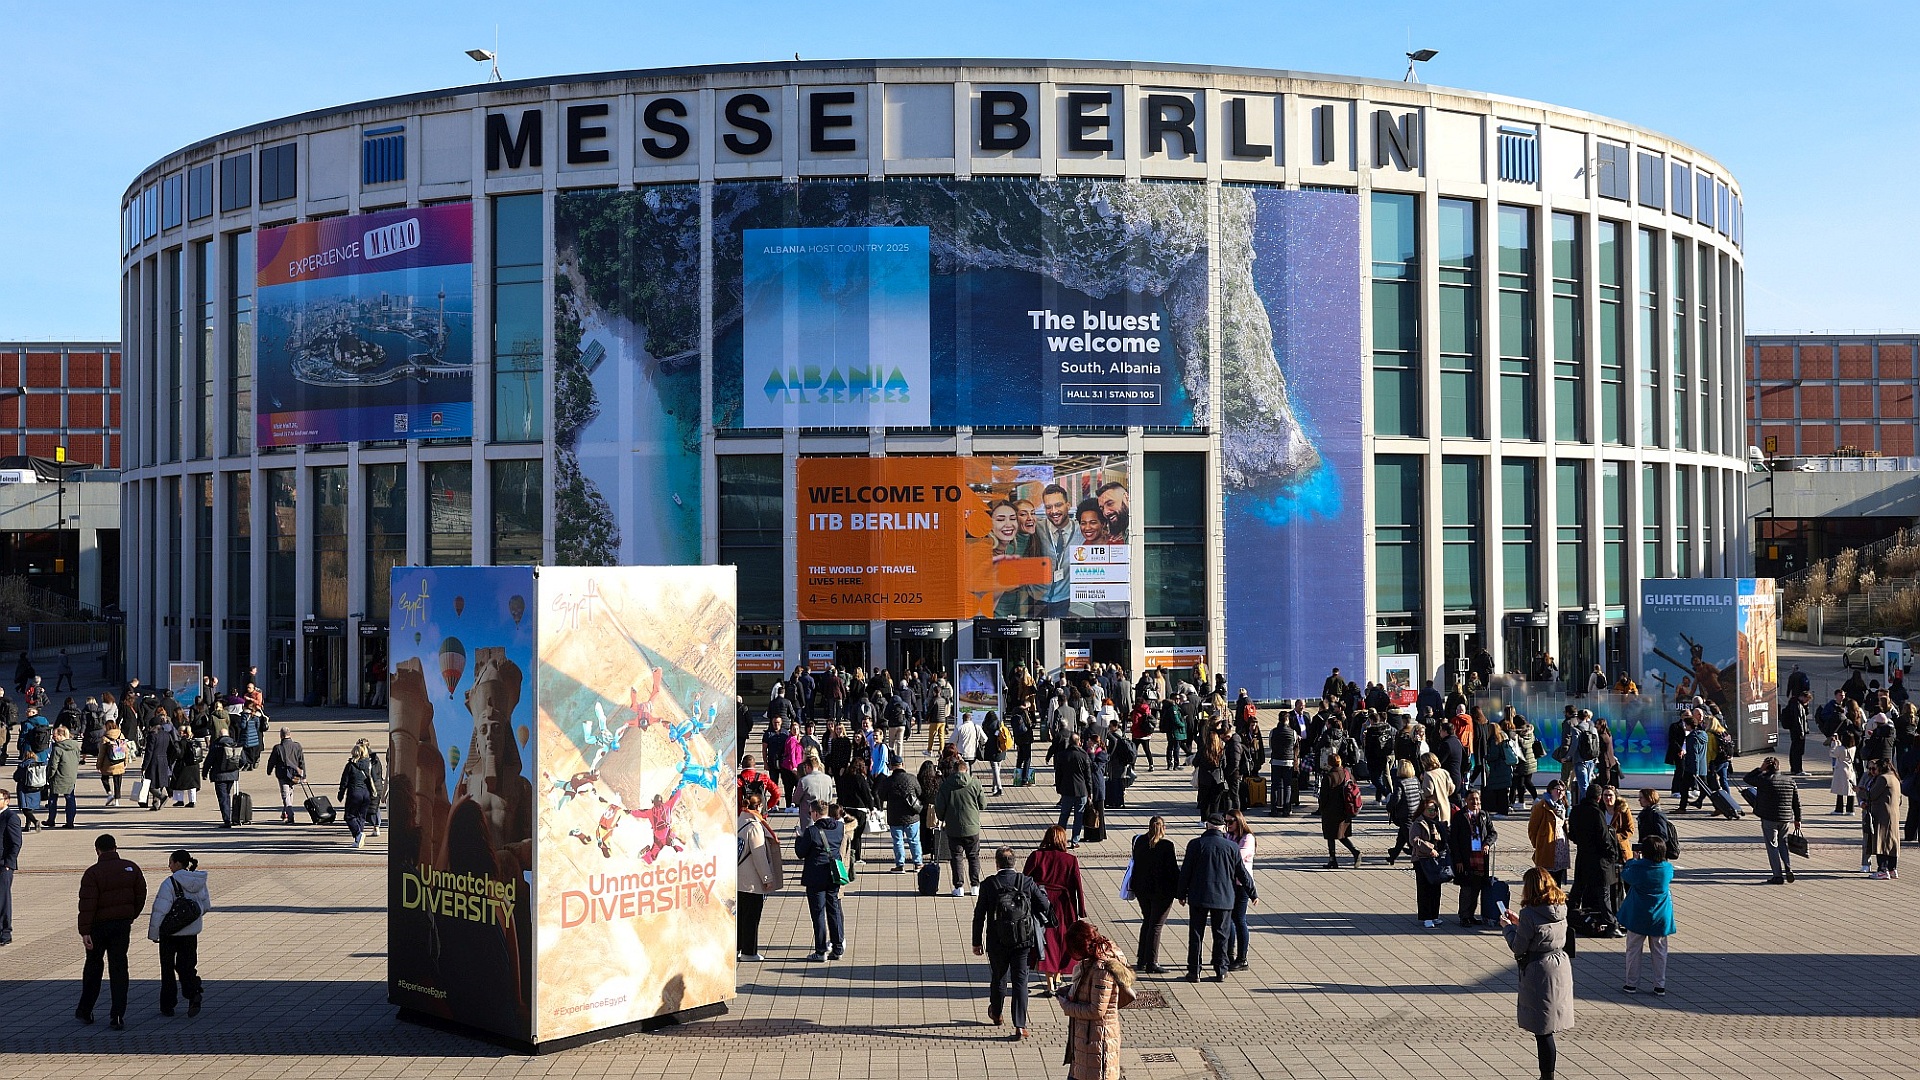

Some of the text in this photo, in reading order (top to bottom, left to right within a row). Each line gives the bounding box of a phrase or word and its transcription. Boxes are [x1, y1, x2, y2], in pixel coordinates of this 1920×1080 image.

[487, 91, 1417, 171] MESSE BERLIN
[289, 222, 415, 278] EXPERIENCE MACAO
[763, 244, 910, 254] ALBANIA HOST COUNTRY 2025
[1028, 310, 1160, 331] The bluest
[1047, 332, 1160, 352] welcome
[763, 364, 909, 390] ALBANIA
[1061, 362, 1160, 375] South, Albania
[808, 485, 962, 503] WELCOME TO
[809, 513, 939, 531] ITB BERLIN!
[1091, 547, 1106, 555] ITB
[809, 566, 826, 574] THE
[829, 566, 863, 574] WORLD
[809, 594, 817, 604] 4
[830, 594, 838, 604] 6
[842, 594, 889, 604] MARCH
[893, 593, 923, 604] 2025
[1645, 594, 1733, 605] GUATEMALA
[1739, 594, 1774, 606] GUATEMALA
[421, 863, 516, 901] Unmatched
[589, 855, 717, 895] Unmatched
[402, 872, 516, 929] DIVERSITY
[561, 880, 716, 929] DIVERSITY
[398, 979, 447, 999] #ExperienceEgypt
[554, 995, 627, 1016] #ExperienceEgypt
